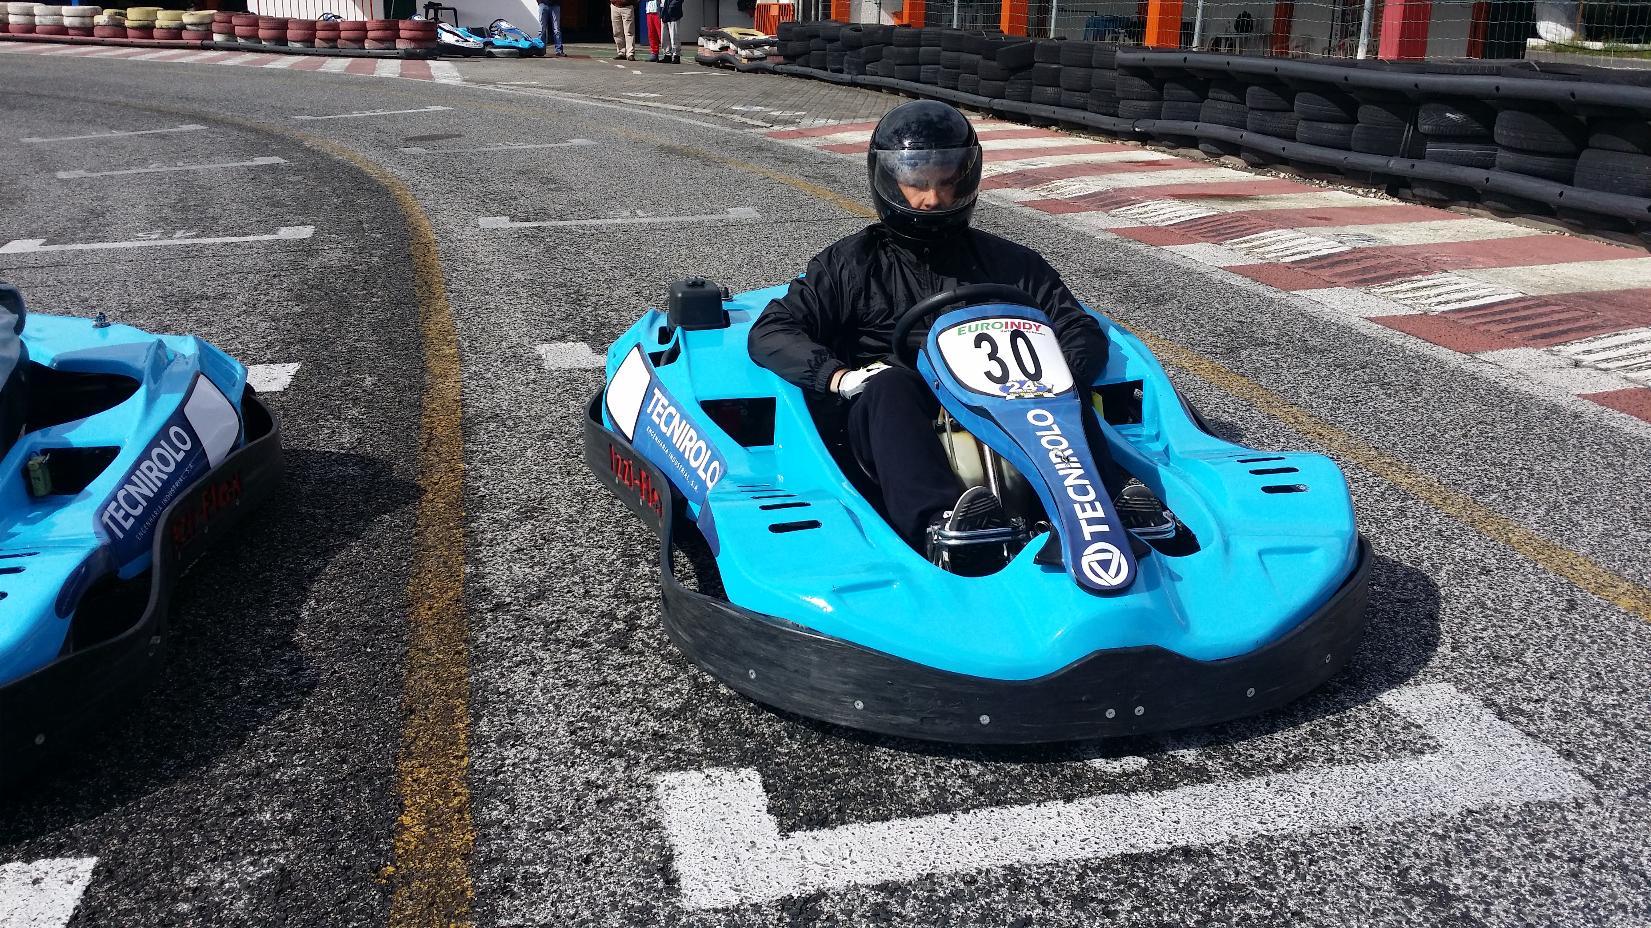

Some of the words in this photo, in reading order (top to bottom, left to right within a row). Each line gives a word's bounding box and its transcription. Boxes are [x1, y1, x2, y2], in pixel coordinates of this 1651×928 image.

[958, 321, 1042, 336] EUROINDY
[974, 328, 1043, 384] 30
[101, 425, 192, 540] TECNIROLO
[646, 387, 721, 490] TECNIROLO
[1026, 409, 1106, 541] TECNIROLO
